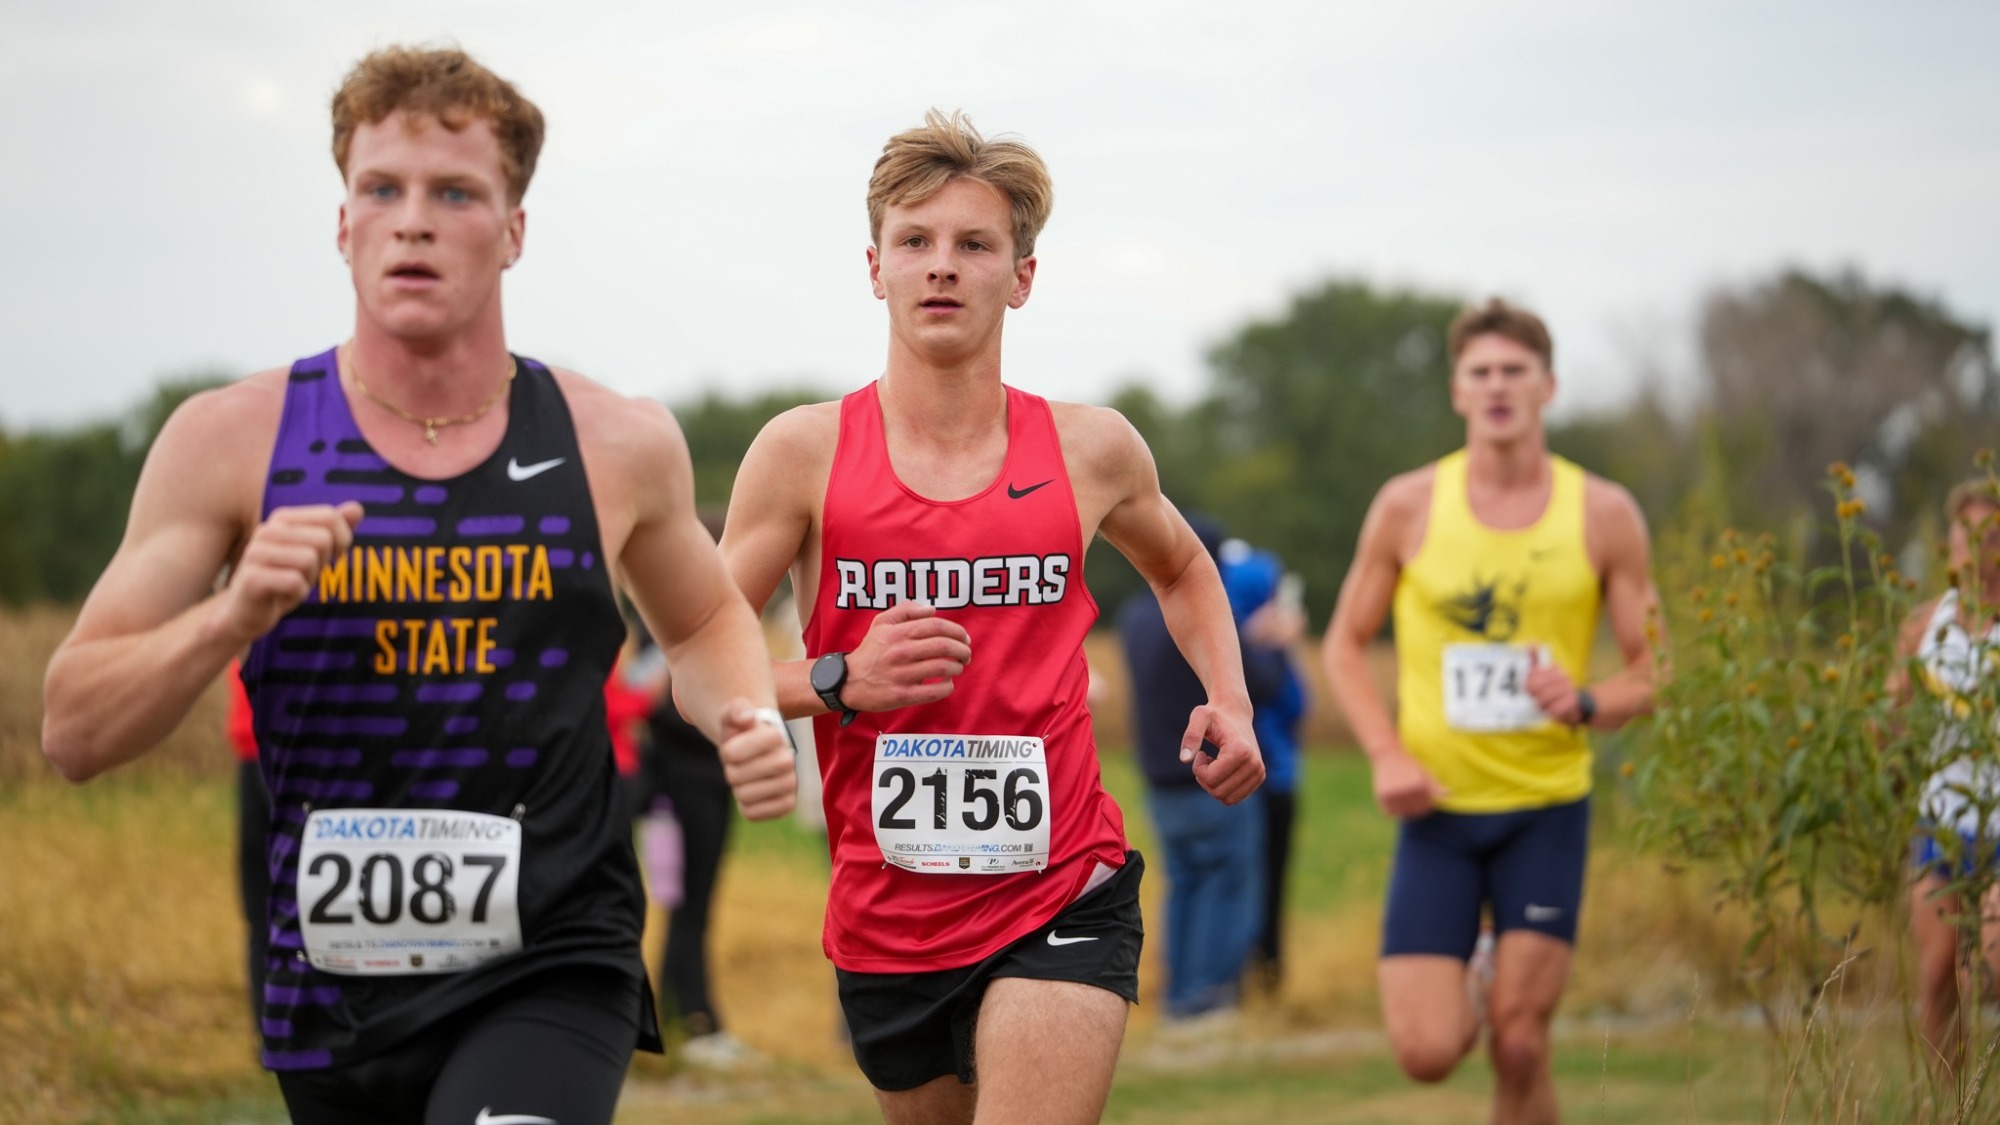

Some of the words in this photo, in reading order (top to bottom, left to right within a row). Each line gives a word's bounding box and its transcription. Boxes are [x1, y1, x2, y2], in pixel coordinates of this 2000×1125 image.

[318, 544, 554, 603] MINNESOTA
[835, 553, 1071, 609] RAIDERS
[374, 617, 498, 675] STATE
[1455, 663, 1520, 699] 174
[884, 739, 1032, 758] DAKOTATIMING
[878, 767, 1043, 831] 2156
[315, 816, 502, 840] DAKOTATIMING
[308, 853, 507, 925] 2087
